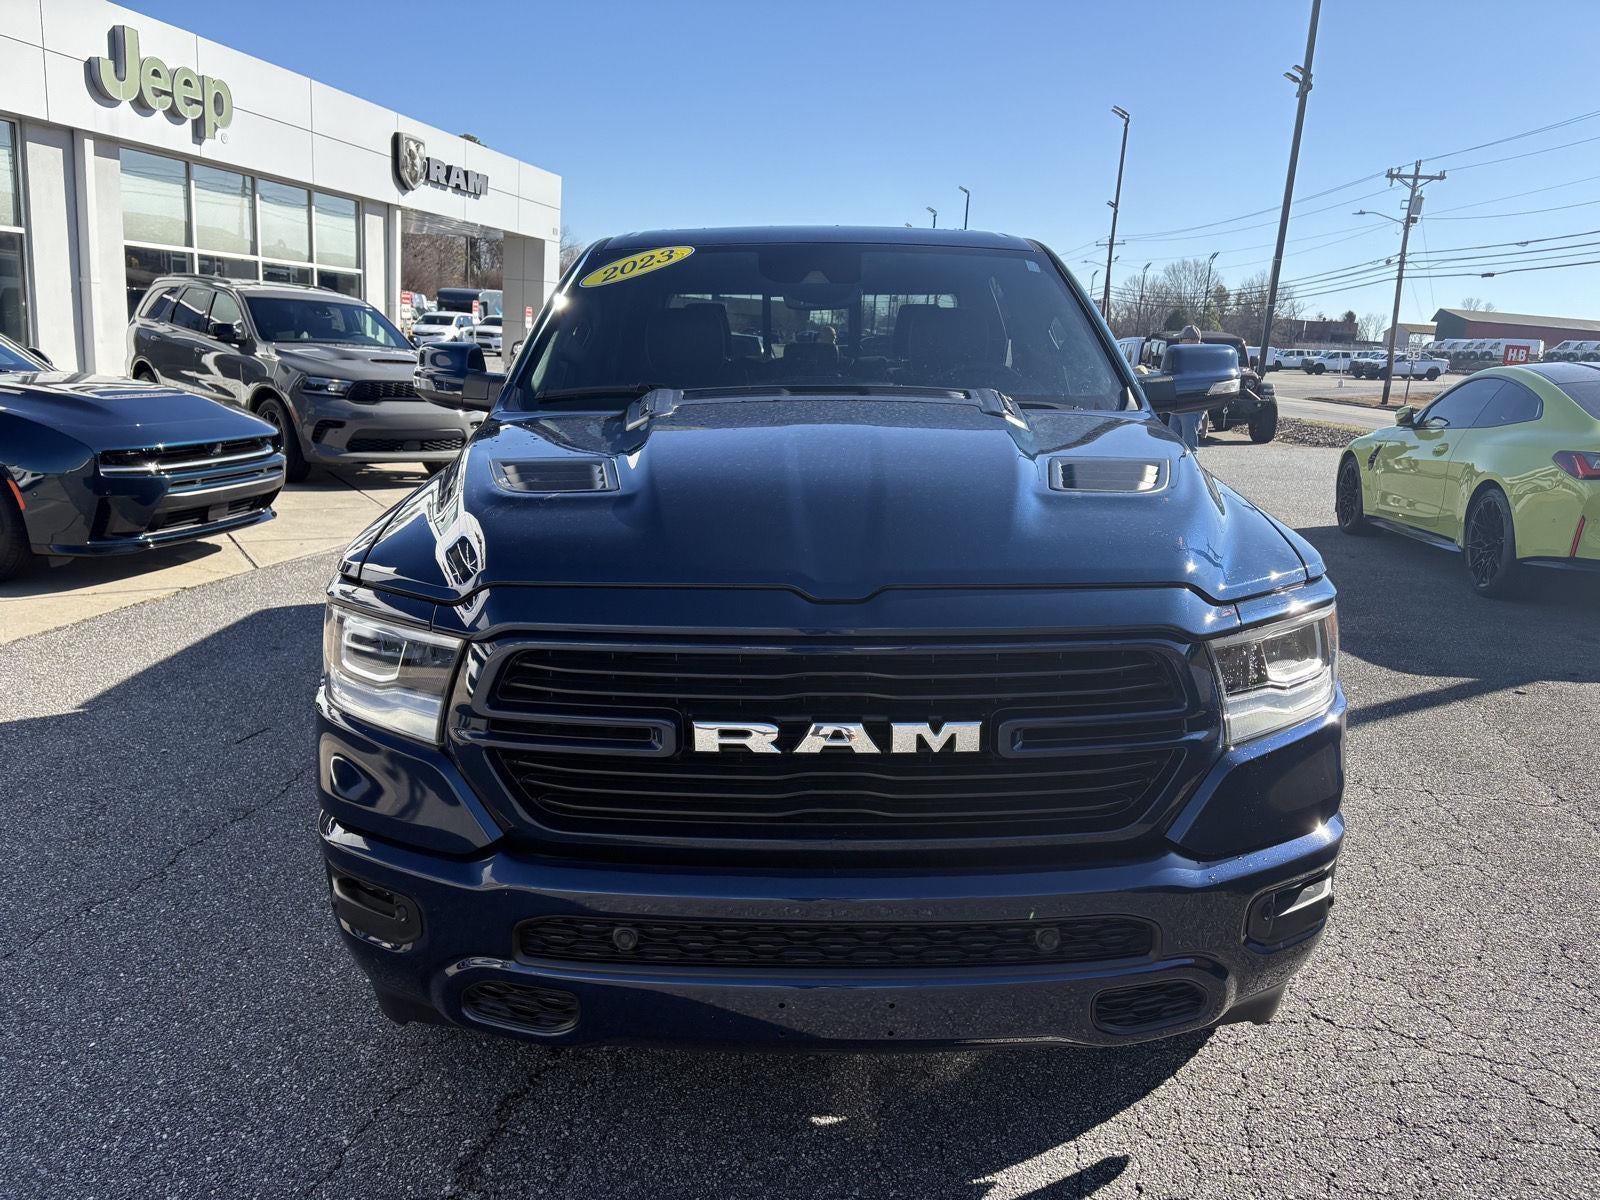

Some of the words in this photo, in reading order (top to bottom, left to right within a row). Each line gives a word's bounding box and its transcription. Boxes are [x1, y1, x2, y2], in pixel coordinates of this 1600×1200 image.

[87, 25, 233, 140] Jeep
[427, 157, 488, 196] RAM
[601, 249, 674, 282] 2023
[1407, 351, 1420, 359] 35
[692, 721, 982, 753] RAM
